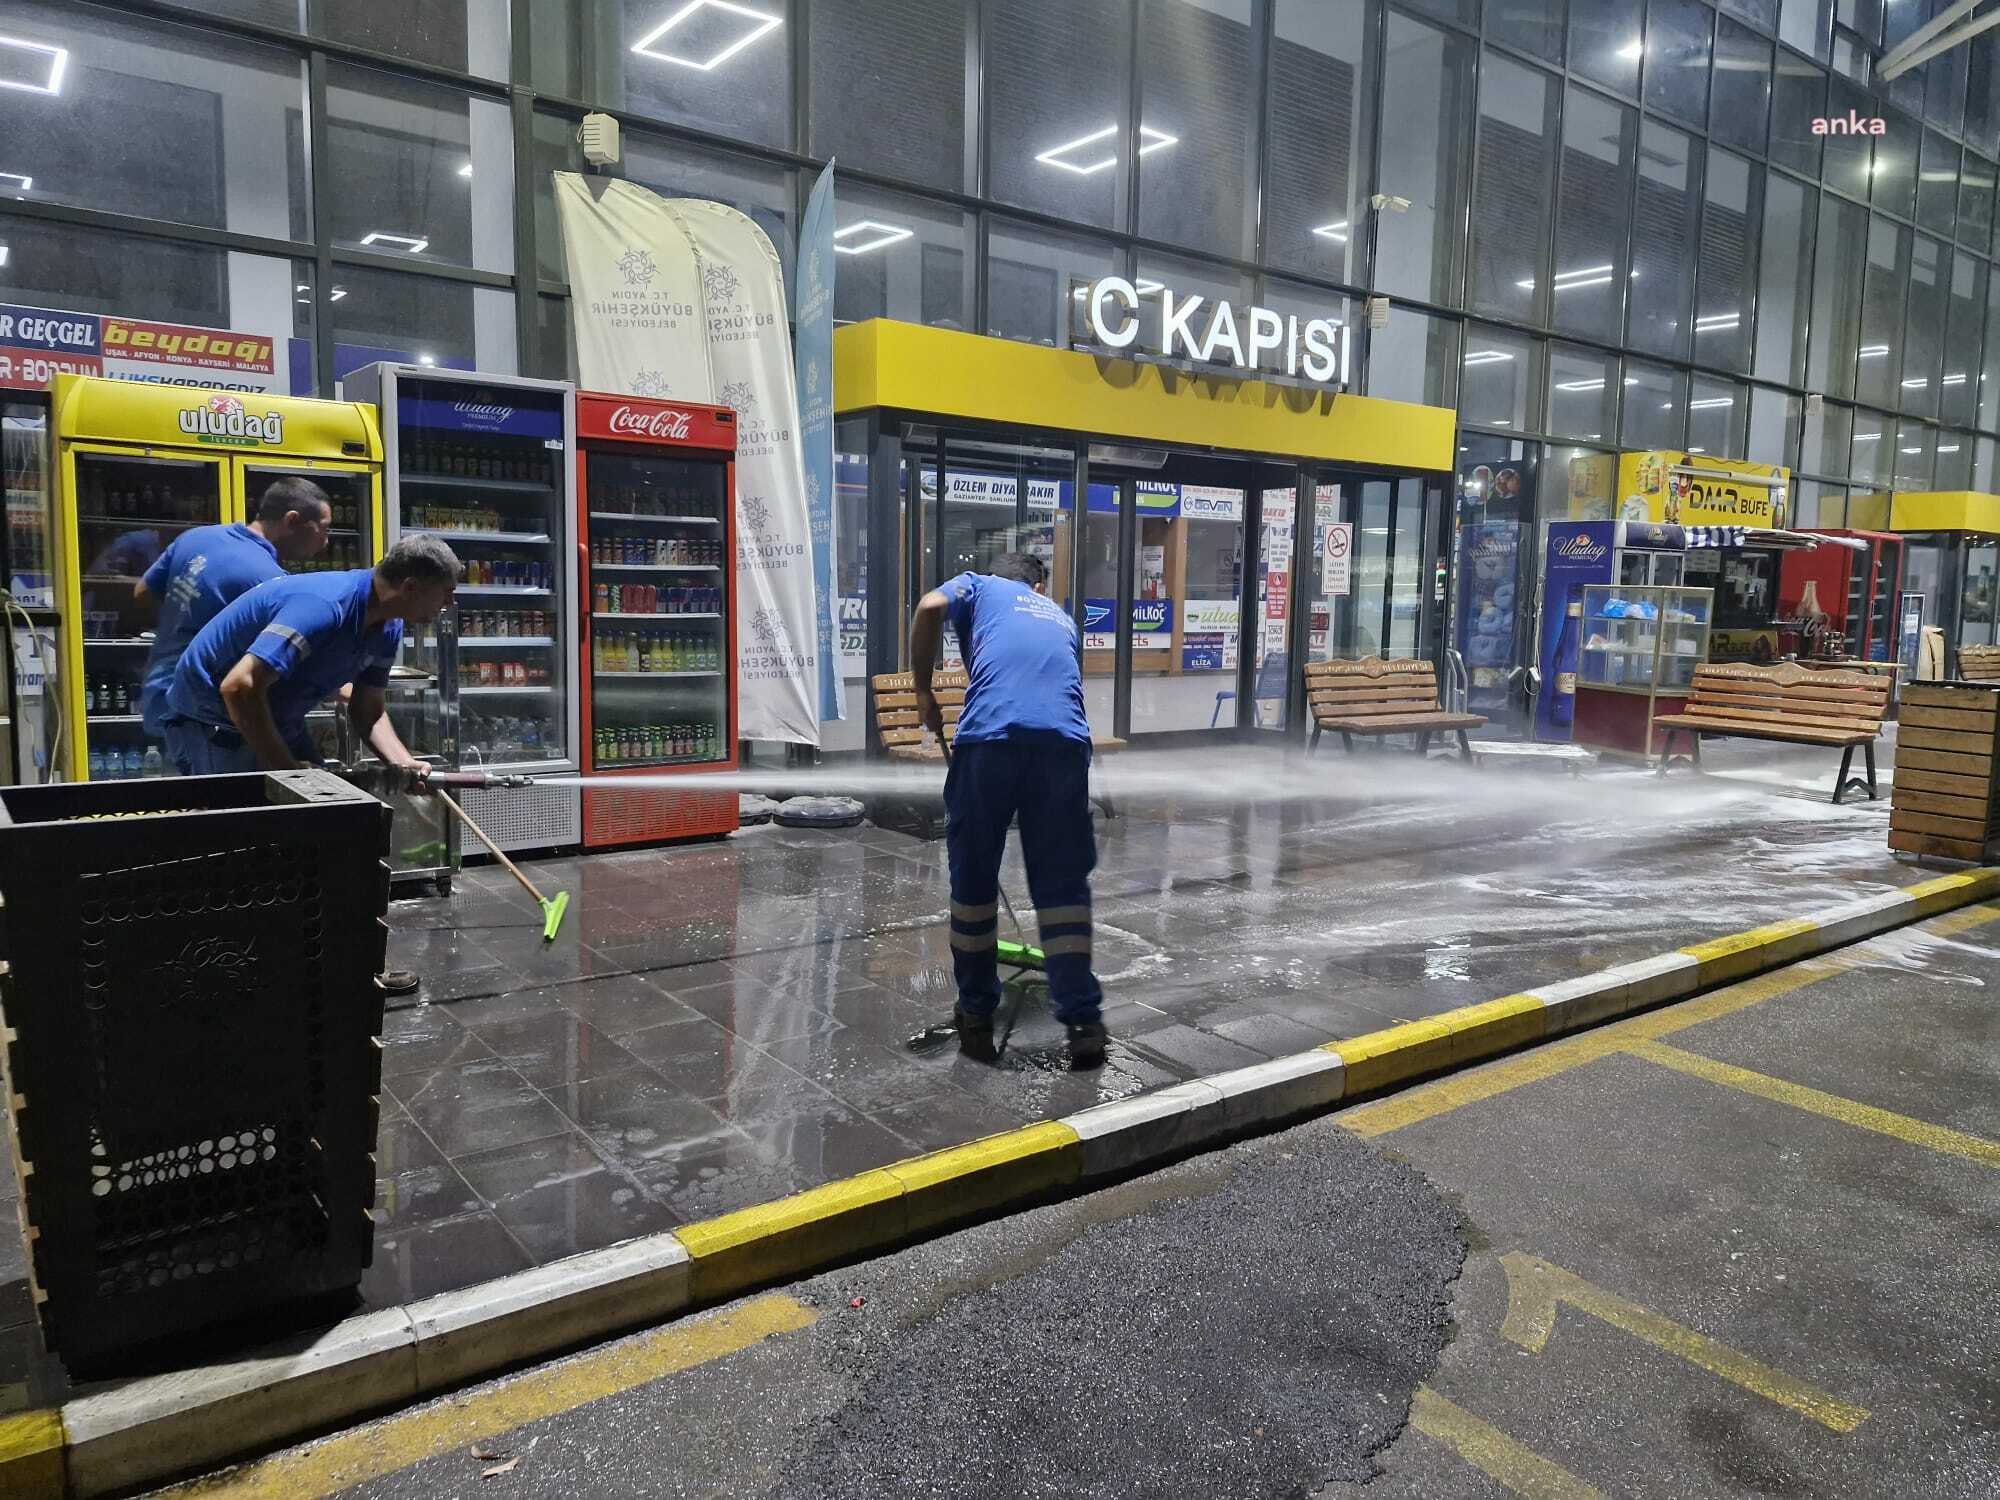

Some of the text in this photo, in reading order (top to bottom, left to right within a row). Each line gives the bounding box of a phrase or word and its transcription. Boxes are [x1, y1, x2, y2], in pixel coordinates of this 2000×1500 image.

[18, 317, 95, 348] GEÇGEL
[103, 324, 272, 363] beydağı
[1091, 276, 1351, 384] C KAPISI
[134, 351, 160, 361] AFYON
[166, 354, 192, 364] KONYA
[235, 362, 269, 372] MALATYA
[179, 405, 283, 444] uludağ
[609, 406, 694, 439] Coca-Cola
[953, 478, 987, 493] ÖZLEM
[1689, 483, 1768, 516] DMR BÜFE
